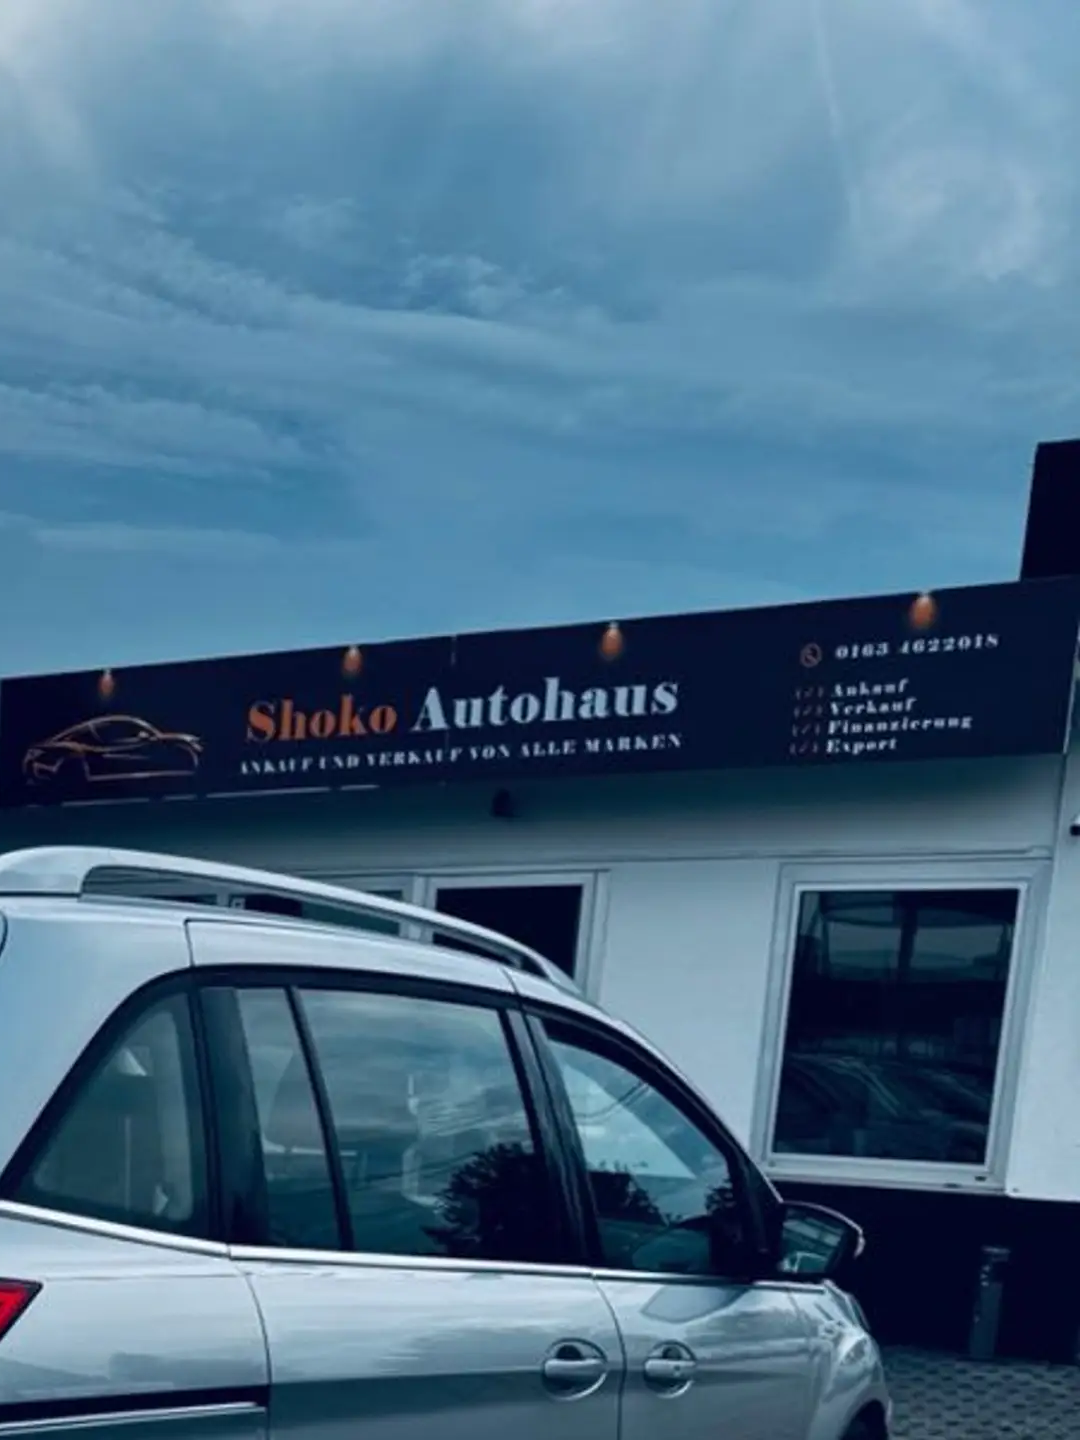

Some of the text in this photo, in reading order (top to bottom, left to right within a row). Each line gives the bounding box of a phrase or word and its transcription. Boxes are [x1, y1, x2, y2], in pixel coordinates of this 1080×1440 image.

[830, 678, 909, 698] Ankauf
[245, 675, 679, 745] Shoko Autohaus
[828, 697, 917, 716] Verkauf
[827, 715, 973, 736] Finanzierung
[240, 732, 683, 775] ANKAUF UND VERKAUF VON ALLE MARKEN
